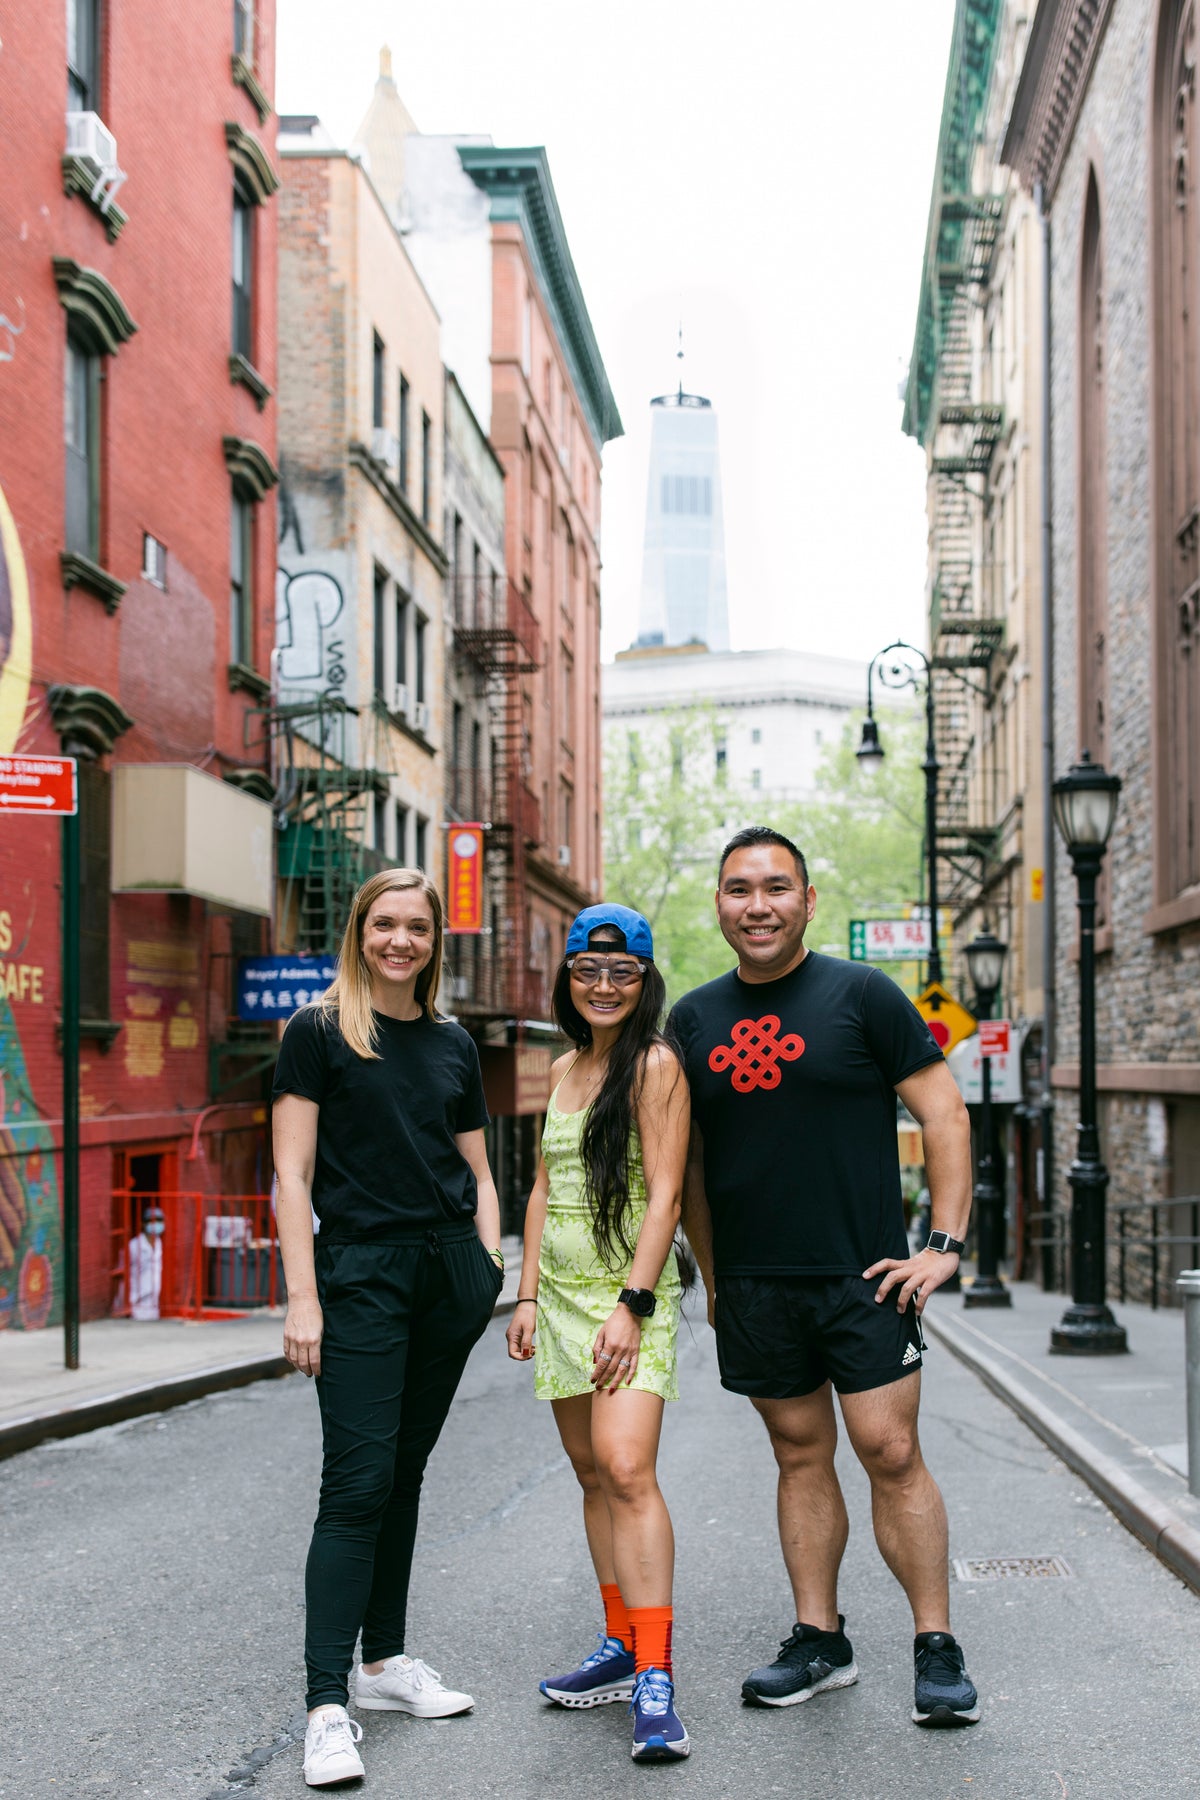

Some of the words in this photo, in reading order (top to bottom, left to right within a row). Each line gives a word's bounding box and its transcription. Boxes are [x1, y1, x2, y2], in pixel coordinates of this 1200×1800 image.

[13, 760, 63, 776] STANDING
[0, 773, 41, 787] Anytime
[245, 968, 279, 983] Mayor
[279, 967, 322, 980] Adams,
